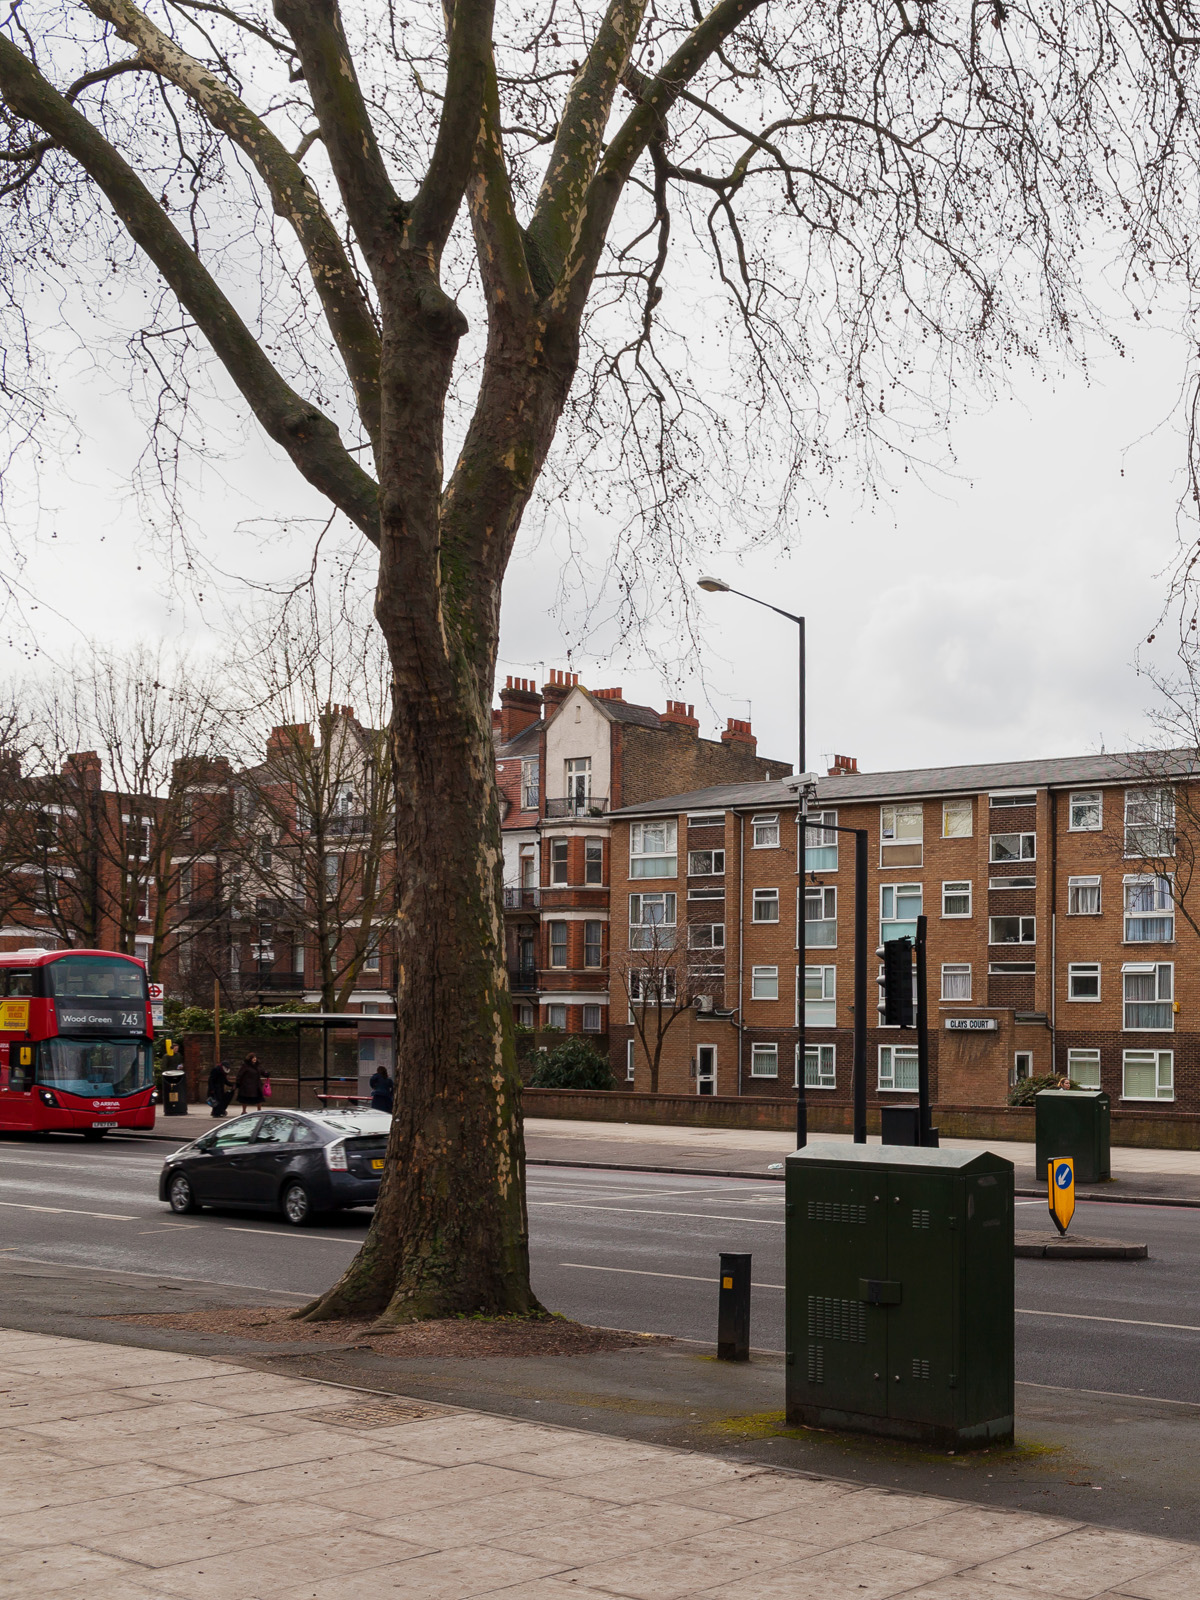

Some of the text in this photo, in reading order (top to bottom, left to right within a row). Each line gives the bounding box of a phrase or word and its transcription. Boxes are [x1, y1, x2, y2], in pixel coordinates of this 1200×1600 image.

[62, 1013, 138, 1026] Wood Green 243
[950, 1020, 989, 1028] CLAYS COURT
